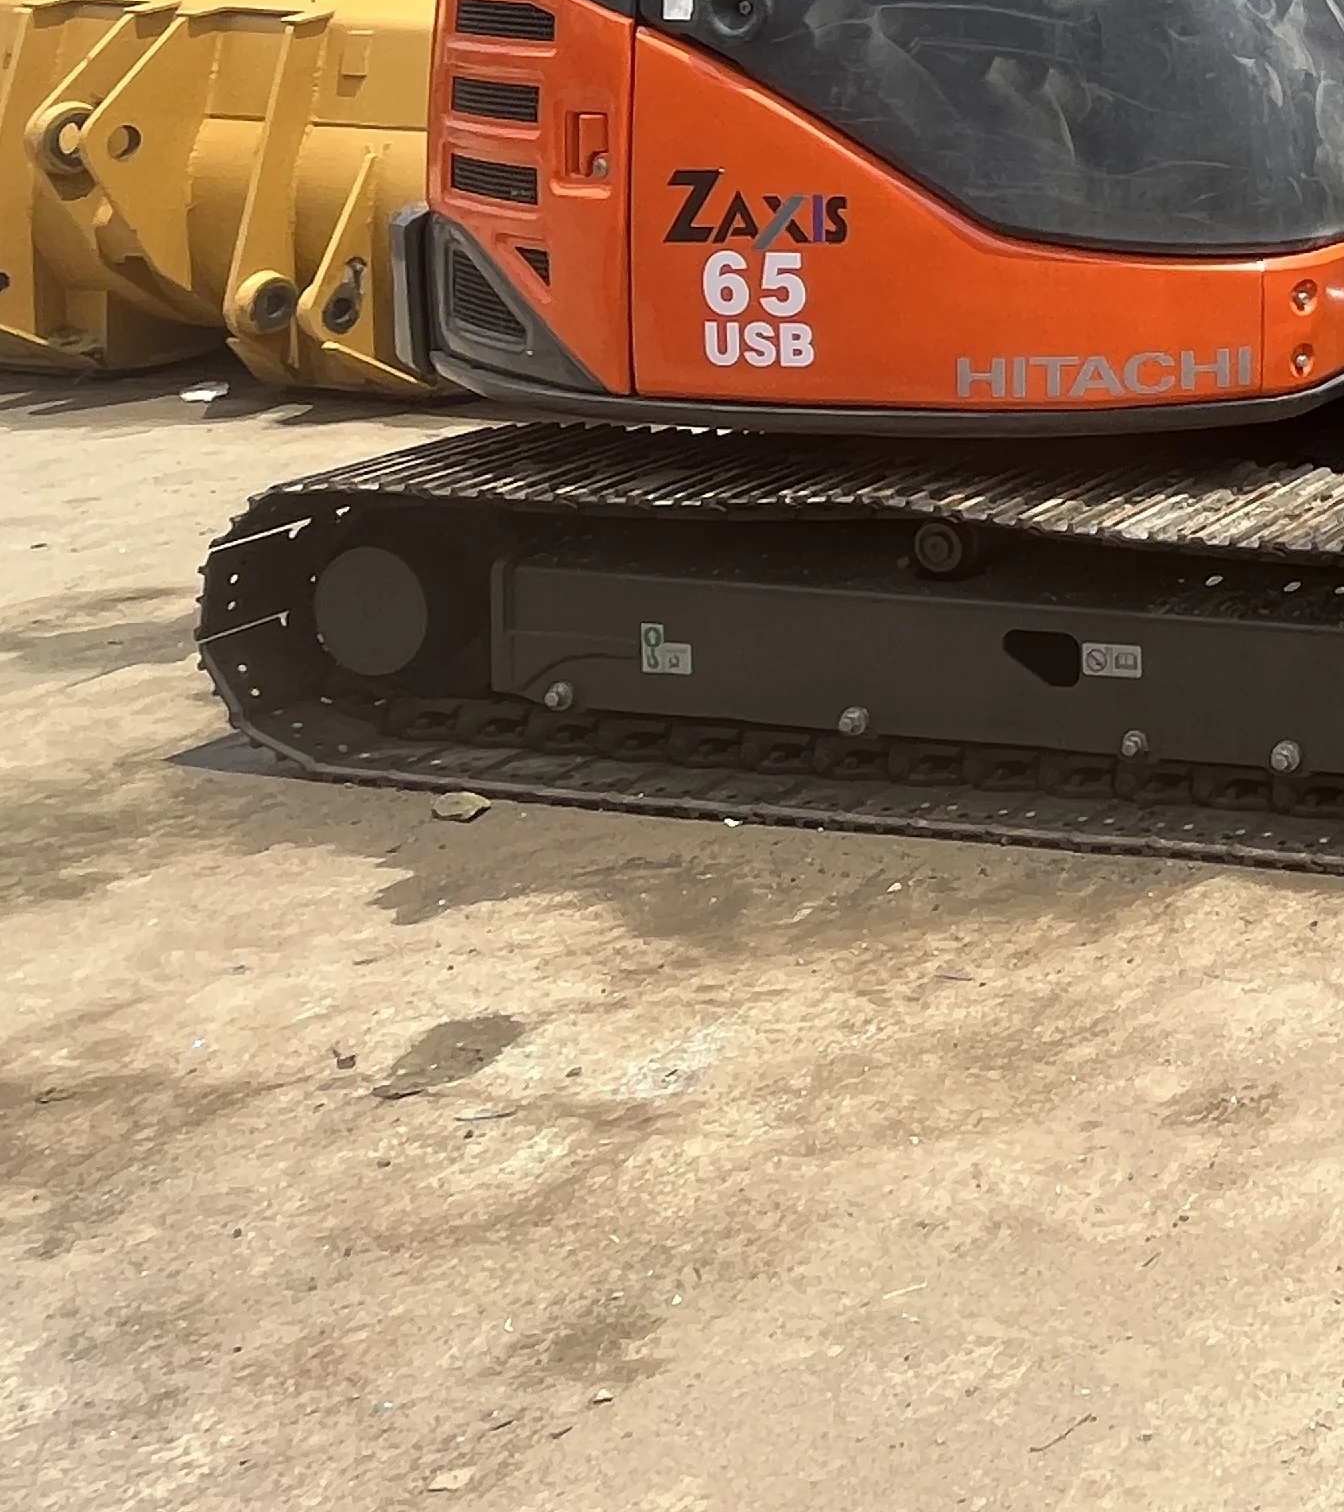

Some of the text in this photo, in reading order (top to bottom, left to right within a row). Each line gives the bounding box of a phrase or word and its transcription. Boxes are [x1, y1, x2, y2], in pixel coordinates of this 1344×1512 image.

[663, 168, 847, 252] ZAXIS
[703, 250, 806, 318] 65
[704, 321, 814, 367] USB
[957, 346, 1251, 398] HITACHI
